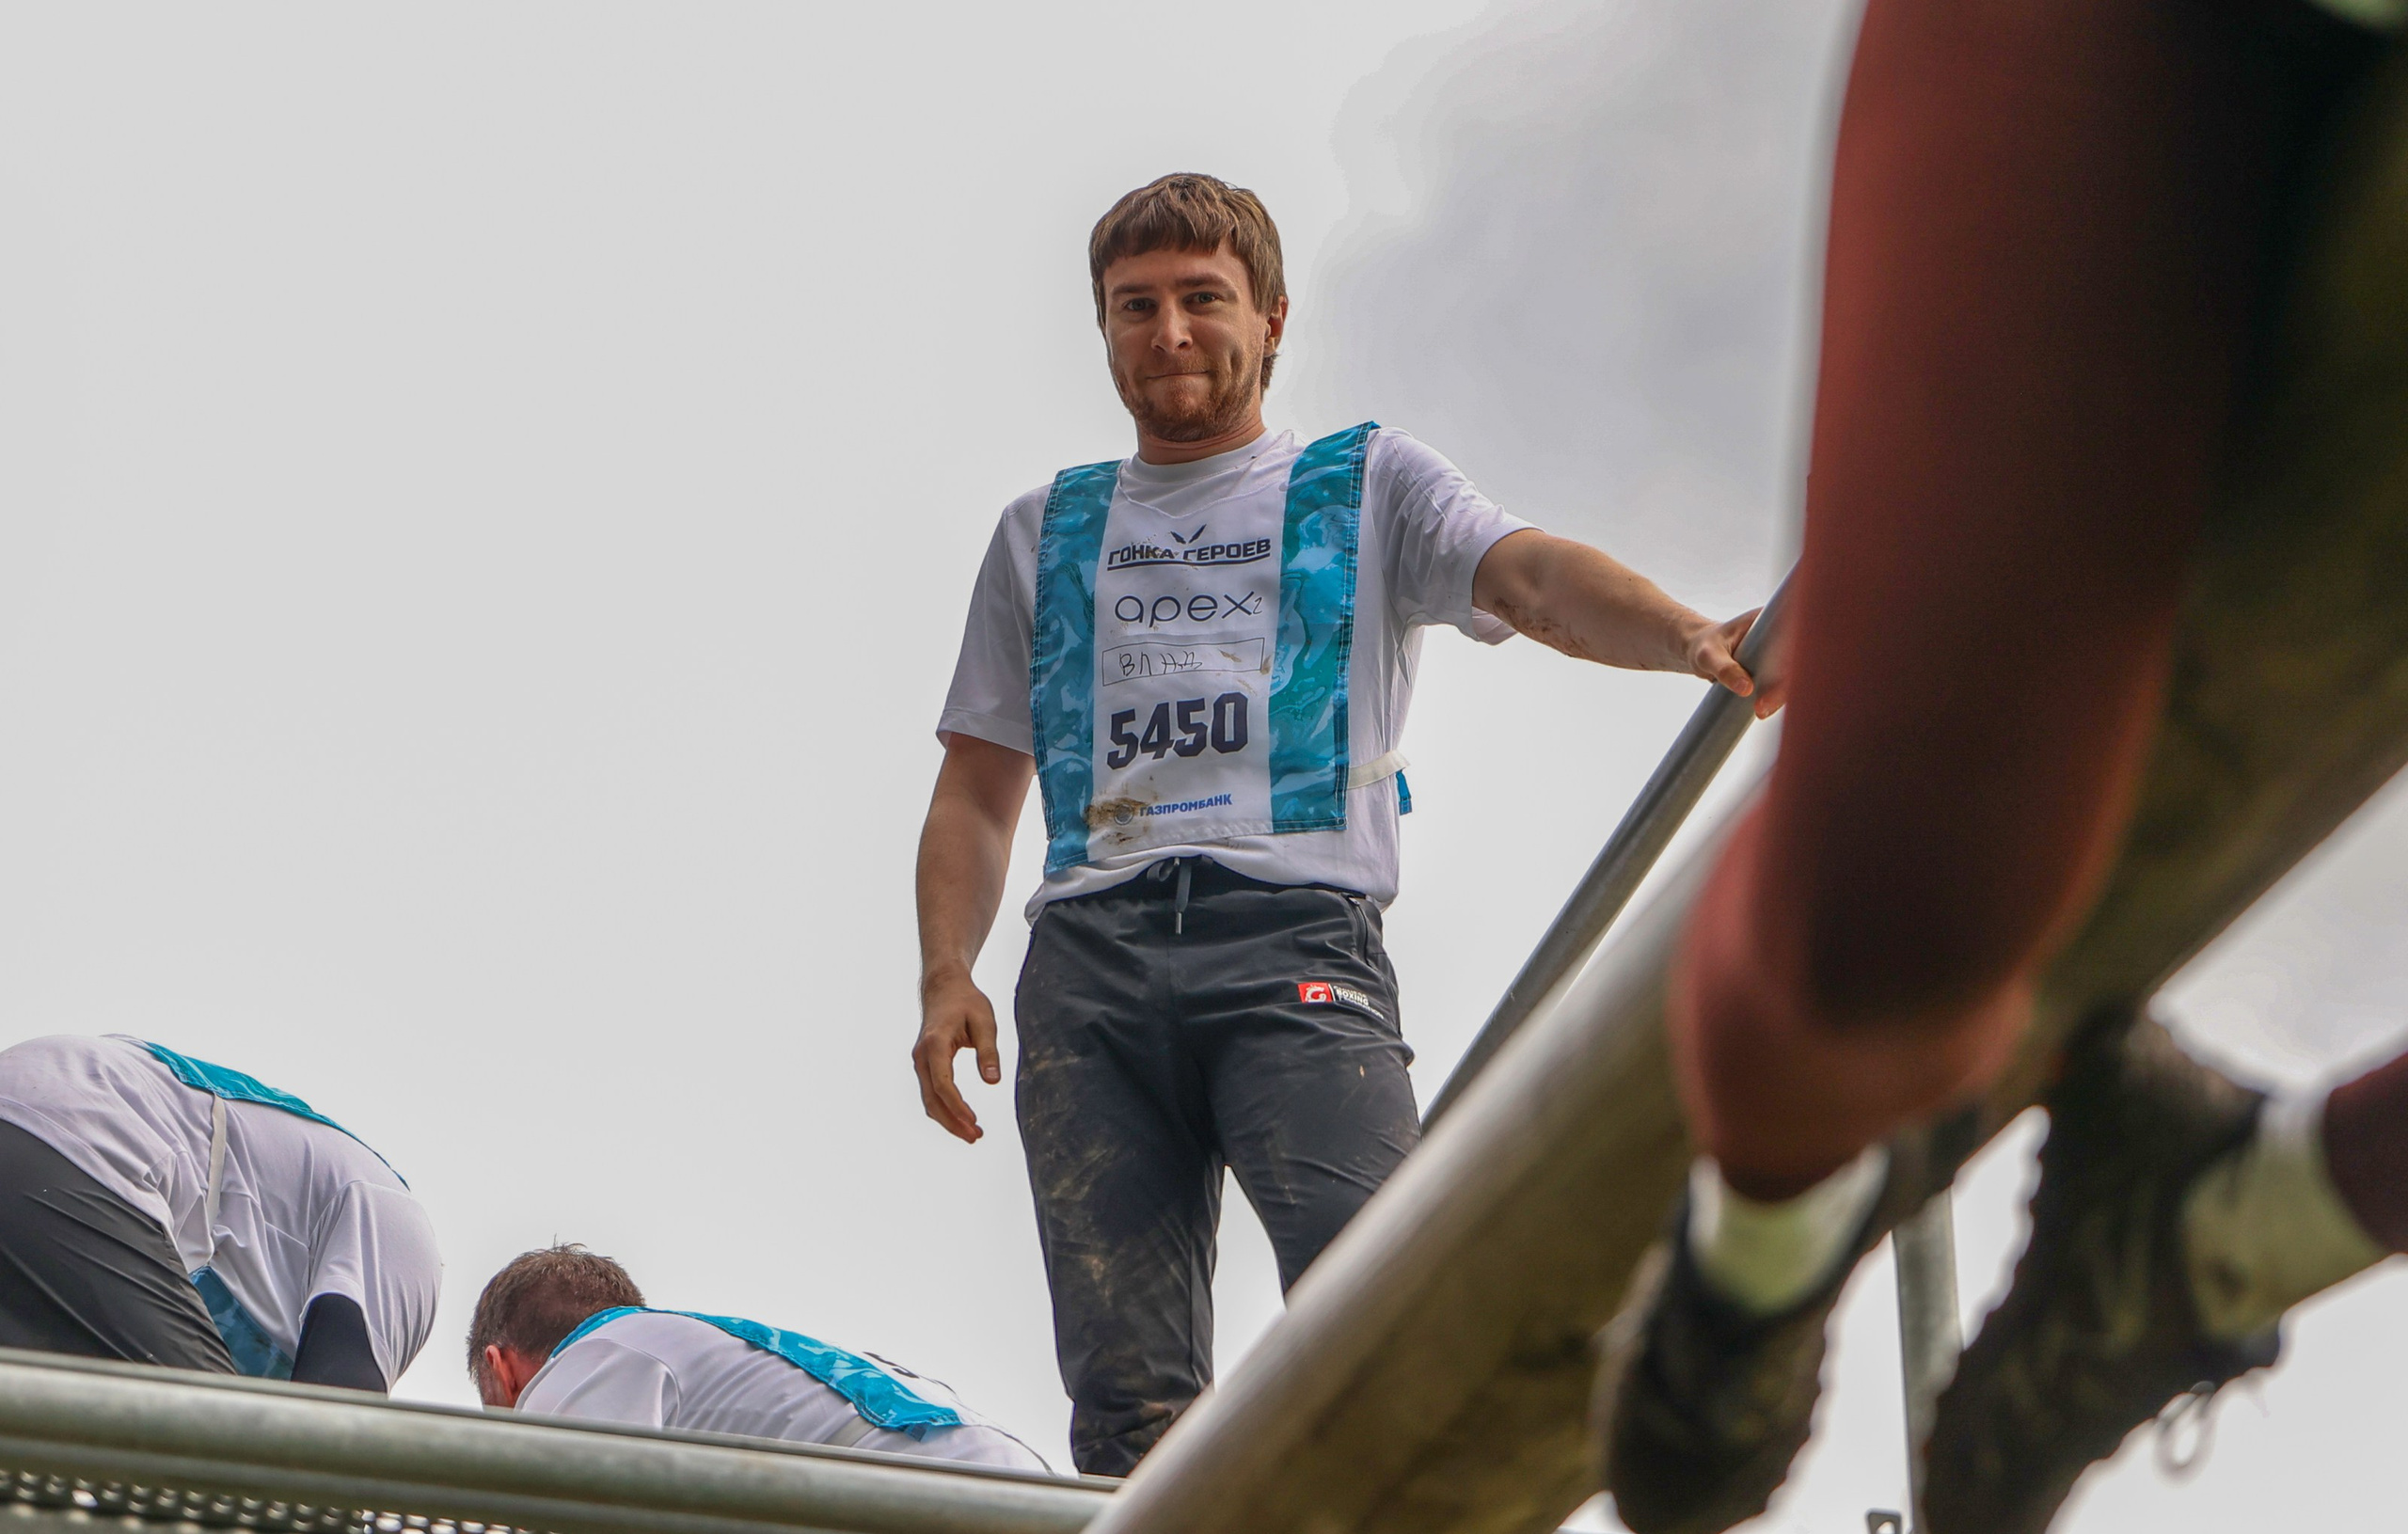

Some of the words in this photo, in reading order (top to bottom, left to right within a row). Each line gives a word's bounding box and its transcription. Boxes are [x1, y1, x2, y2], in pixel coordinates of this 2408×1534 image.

[1107, 544, 1175, 565] ГОНКА
[1182, 538, 1272, 562] ГЕРОЕВ
[1115, 591, 1255, 628] apex
[1106, 691, 1249, 770] 5450
[1139, 794, 1233, 816] ГАЗПРОМБАНК
